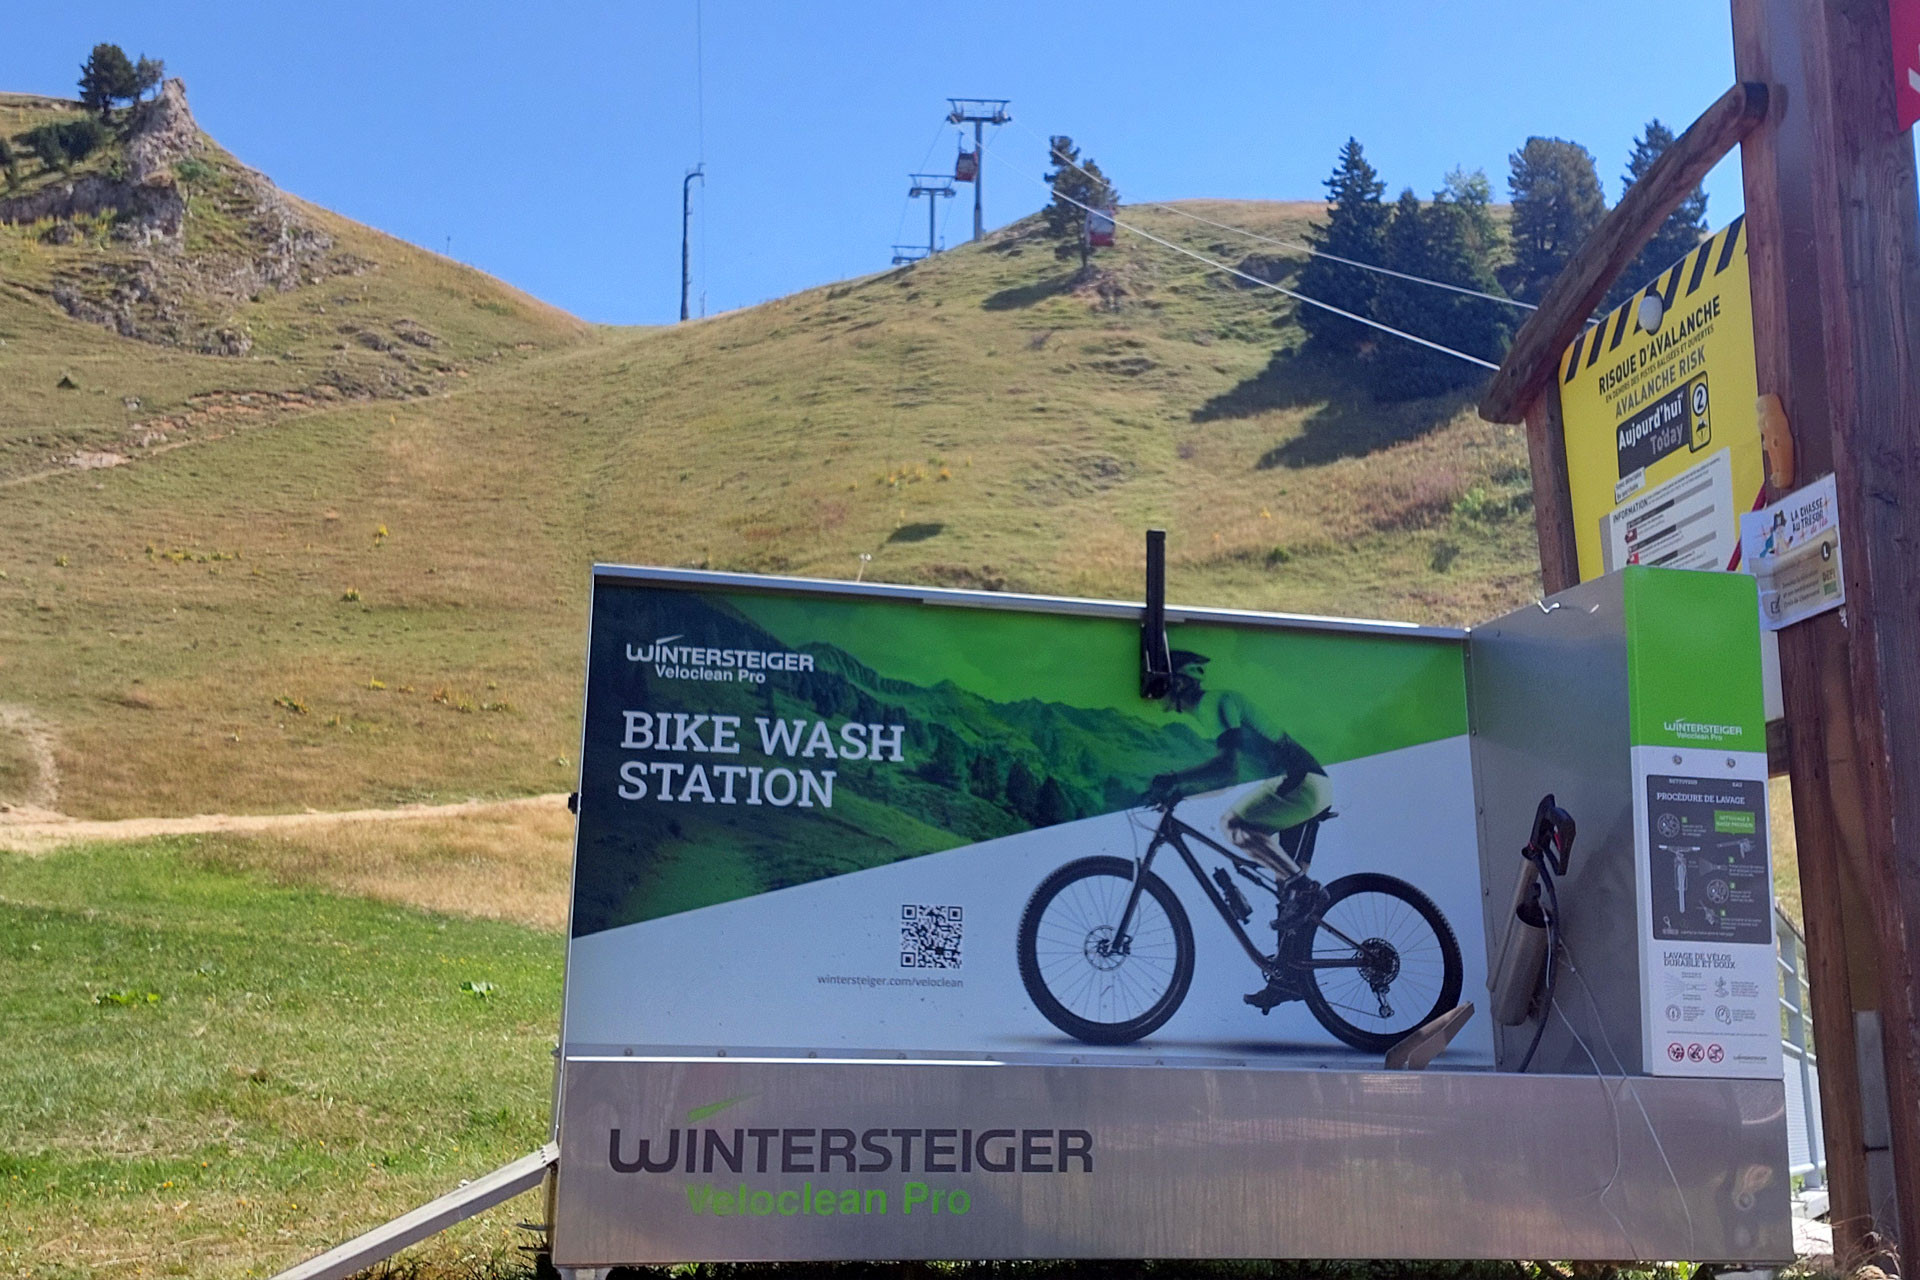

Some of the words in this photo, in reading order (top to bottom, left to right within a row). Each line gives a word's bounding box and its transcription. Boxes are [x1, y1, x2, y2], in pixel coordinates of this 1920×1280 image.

[1599, 354, 1637, 395] RISQUE
[1639, 295, 1720, 368] D'AVALANCHE
[1640, 365, 1656, 379] PISTES
[1680, 343, 1687, 354] ET
[1687, 323, 1714, 348] OUVERTES
[1616, 364, 1677, 419] AVALANCHE
[1679, 344, 1706, 378] RISK
[1696, 389, 1704, 411] 2
[1619, 394, 1683, 451] Aujourd'hui
[1650, 424, 1684, 455] Today
[1791, 509, 1799, 522] LA
[1800, 497, 1823, 517] CHASSE
[1792, 522, 1801, 533] AU
[626, 640, 815, 672] WINTERSTEIGER
[655, 664, 733, 682] Veloclean
[737, 667, 766, 684] Pro
[620, 710, 741, 754] BIKE
[754, 717, 905, 762] WASH
[1664, 720, 1742, 736] WINTERSTEIGER
[1710, 733, 1723, 741] Pro
[618, 760, 837, 808] STATION
[1656, 791, 1703, 802] PROCÉDURE
[1704, 793, 1715, 803] DE
[1716, 795, 1745, 805] LAVAGE
[1663, 951, 1693, 960] LAVAGE
[1694, 952, 1706, 961] DE
[1663, 960, 1700, 968] DURABLE
[1701, 960, 1711, 968] ET
[1713, 961, 1736, 969] DOUX
[817, 974, 964, 988] wintersteiger.com/veloclean
[608, 1126, 1095, 1174] WINTERSTEIGER
[686, 1181, 888, 1218] Veloclean
[902, 1181, 972, 1216] Pro
